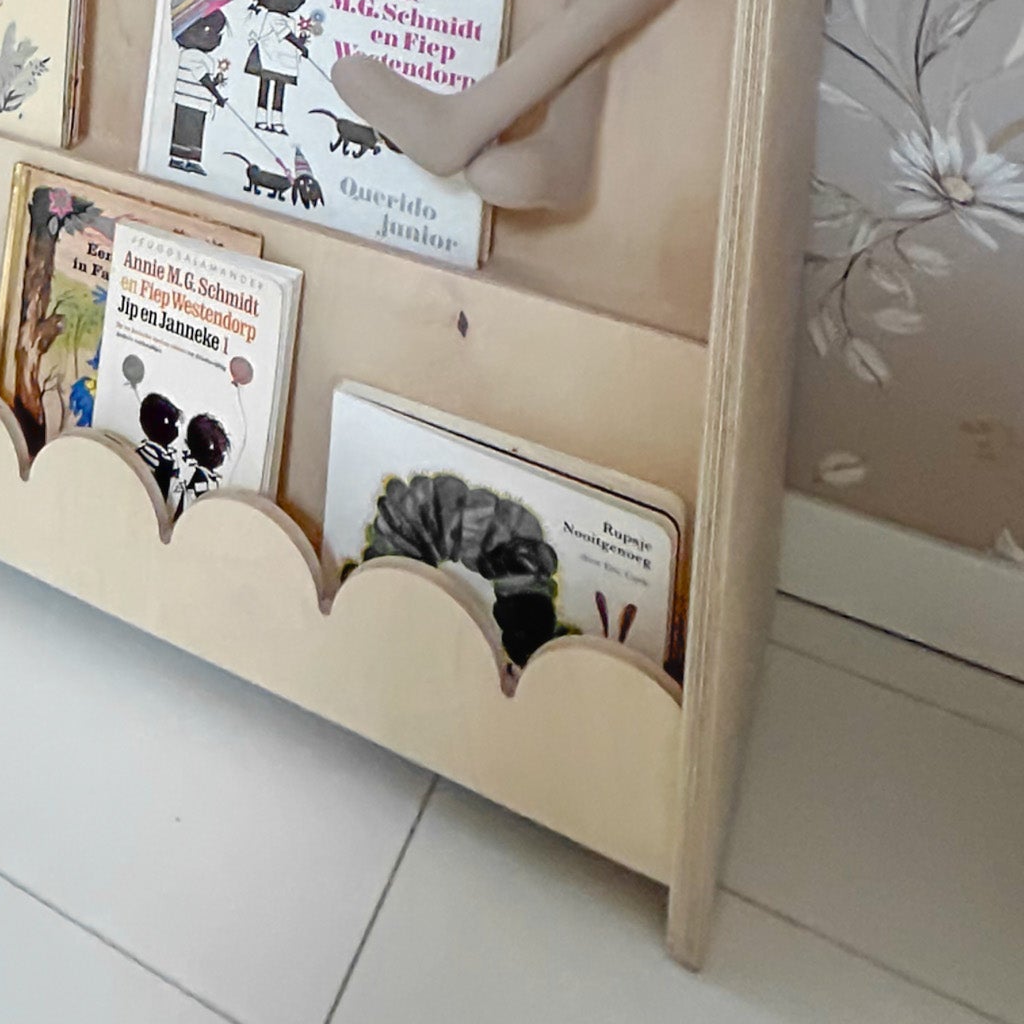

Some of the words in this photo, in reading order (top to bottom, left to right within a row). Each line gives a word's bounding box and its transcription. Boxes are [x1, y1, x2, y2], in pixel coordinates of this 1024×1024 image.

[381, 2, 483, 42] Schmidt
[370, 29, 398, 47] en
[403, 31, 456, 65] Fiep
[340, 176, 437, 221] Querido
[72, 257, 87, 273] in
[123, 250, 165, 280] Annie
[167, 264, 196, 293] M.G.
[197, 276, 260, 318] Schmidt
[117, 295, 138, 321] Jip
[140, 306, 158, 327] en
[159, 310, 220, 351] Janneke
[121, 275, 137, 294] en
[139, 277, 170, 312] Fiep
[170, 287, 257, 345] Westendorp
